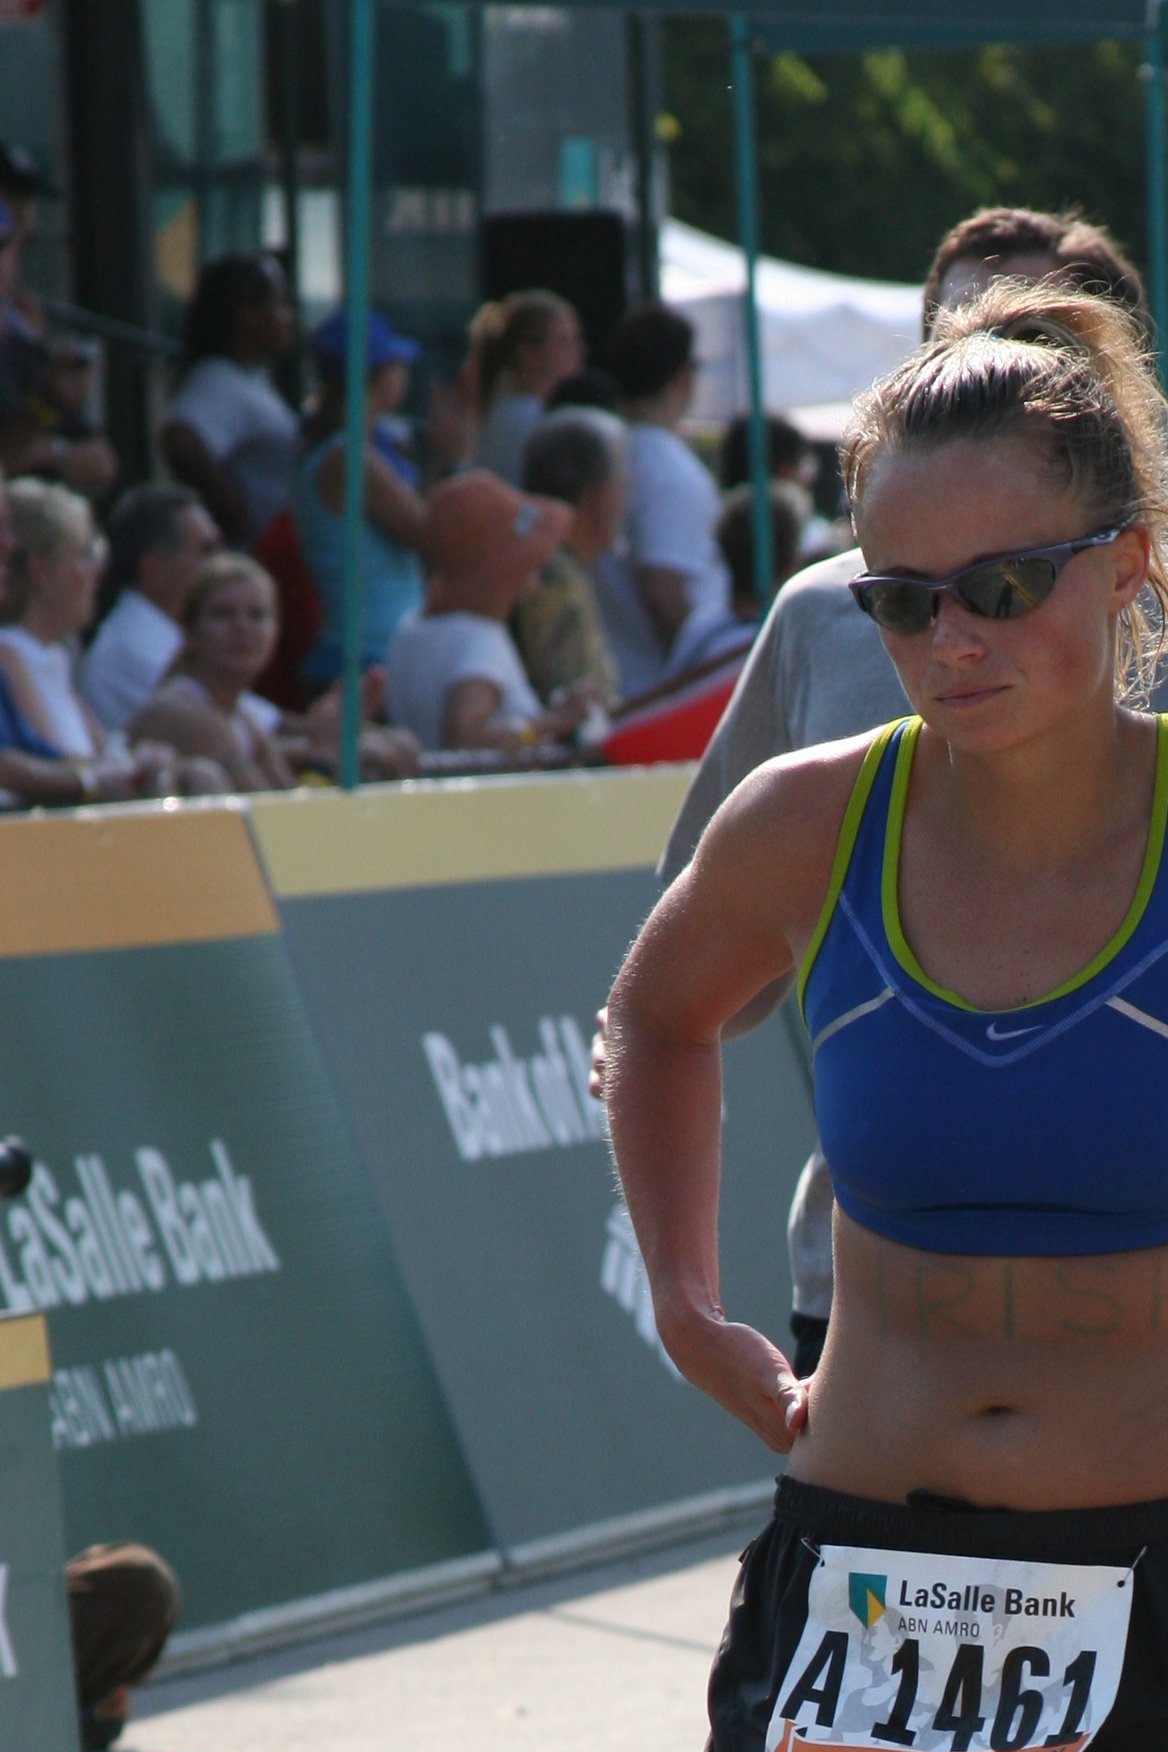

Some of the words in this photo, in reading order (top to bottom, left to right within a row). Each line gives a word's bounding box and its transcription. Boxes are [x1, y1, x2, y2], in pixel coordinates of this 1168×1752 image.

[135, 1136, 280, 1287] Bank
[898, 1617, 928, 1633] ABN
[933, 1619, 981, 1638] AMRO
[900, 1580, 995, 1613] LaSalle
[1004, 1588, 1076, 1618] Bank
[779, 1630, 849, 1728] A
[871, 1639, 1098, 1752] 1461
